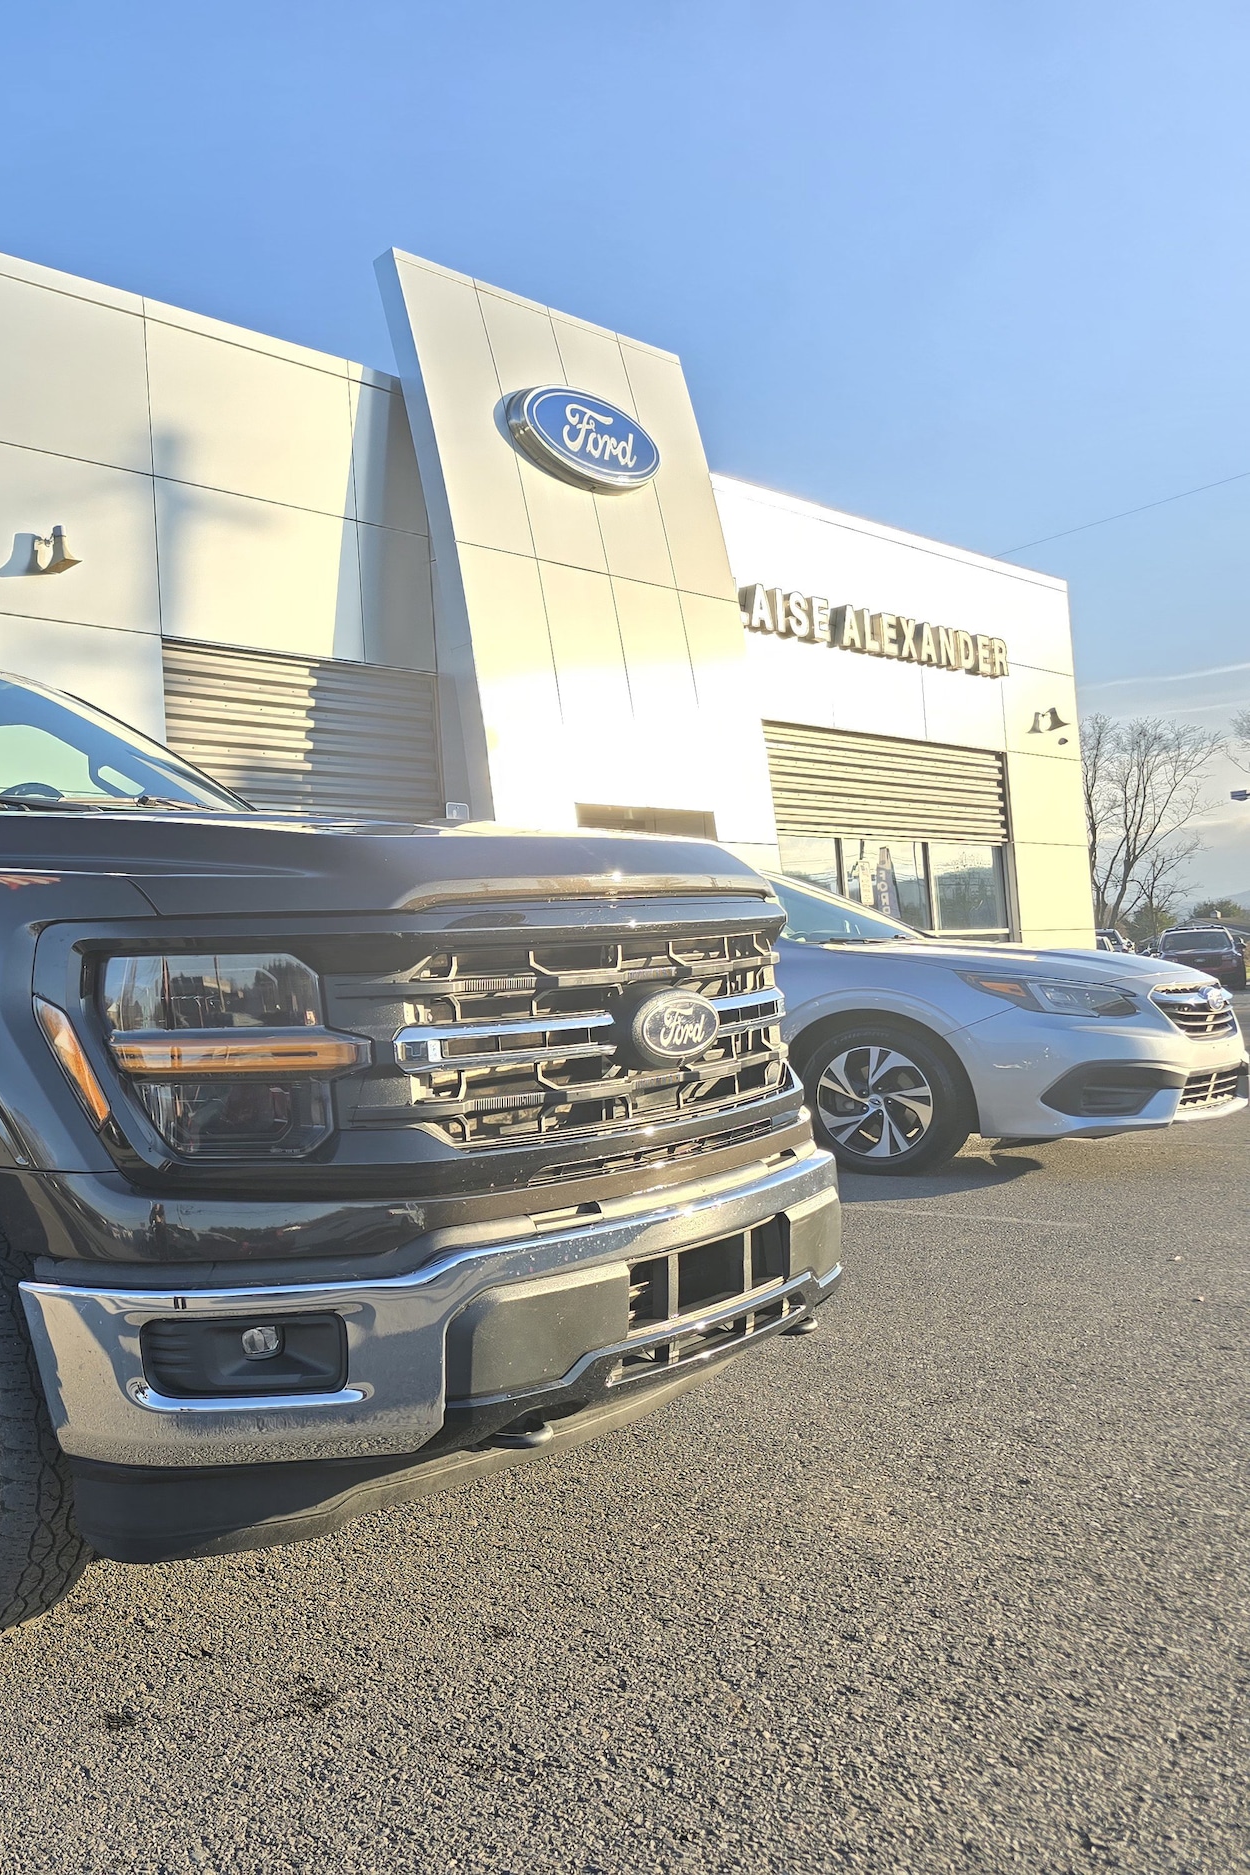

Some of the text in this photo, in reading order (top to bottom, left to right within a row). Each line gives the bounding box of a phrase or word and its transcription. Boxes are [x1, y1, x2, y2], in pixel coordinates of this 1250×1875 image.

[562, 403, 637, 468] Ford
[733, 578, 1010, 677] AISE ALEXANDER
[660, 1006, 705, 1047] Ford
